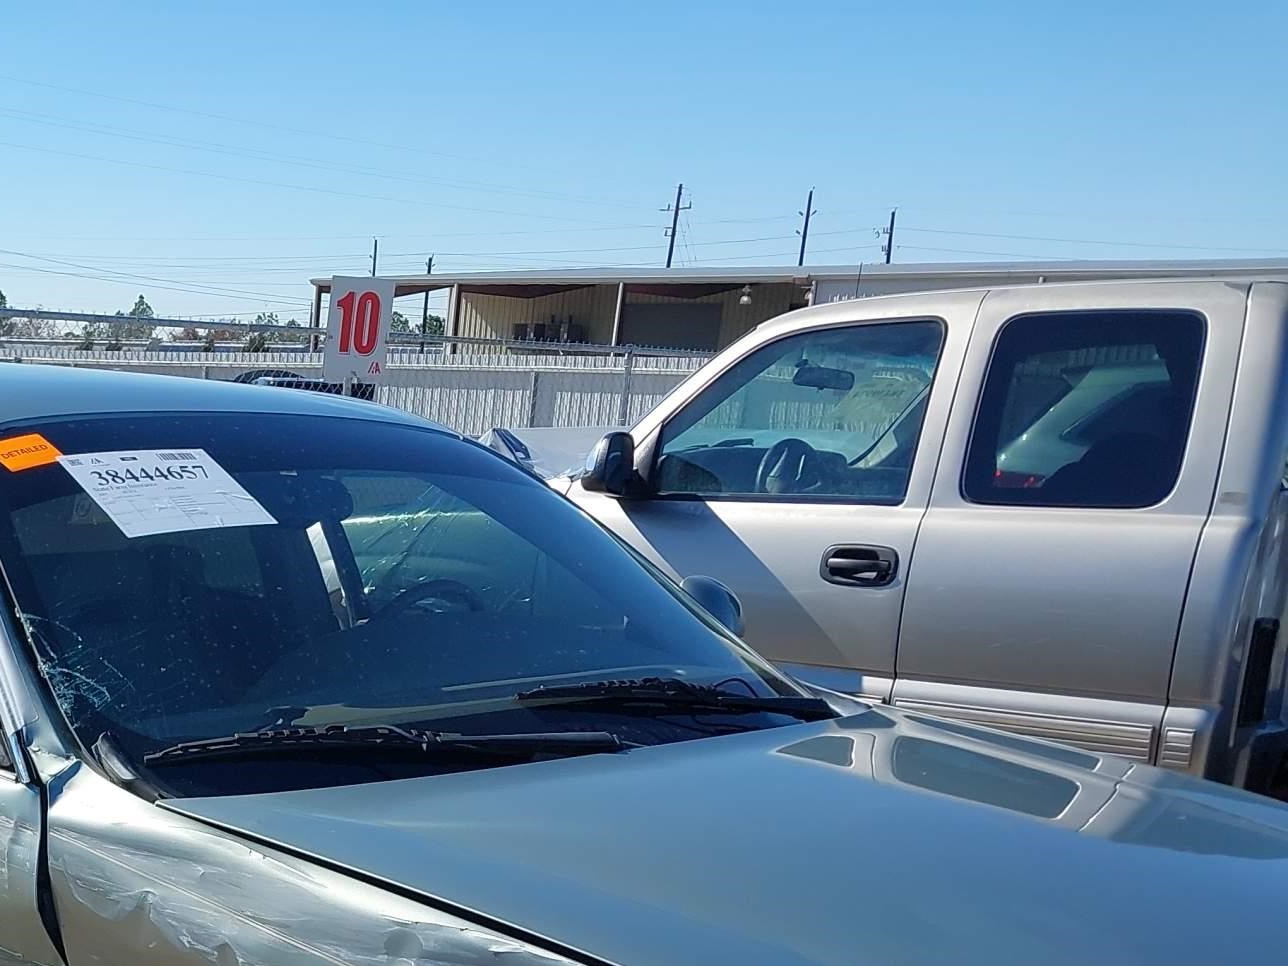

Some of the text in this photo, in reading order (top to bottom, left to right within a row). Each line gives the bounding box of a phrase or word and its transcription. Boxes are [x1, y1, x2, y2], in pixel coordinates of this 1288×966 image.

[337, 291, 380, 355] 10
[0, 444, 48, 460] DETAILED
[89, 465, 210, 486] 38444657
